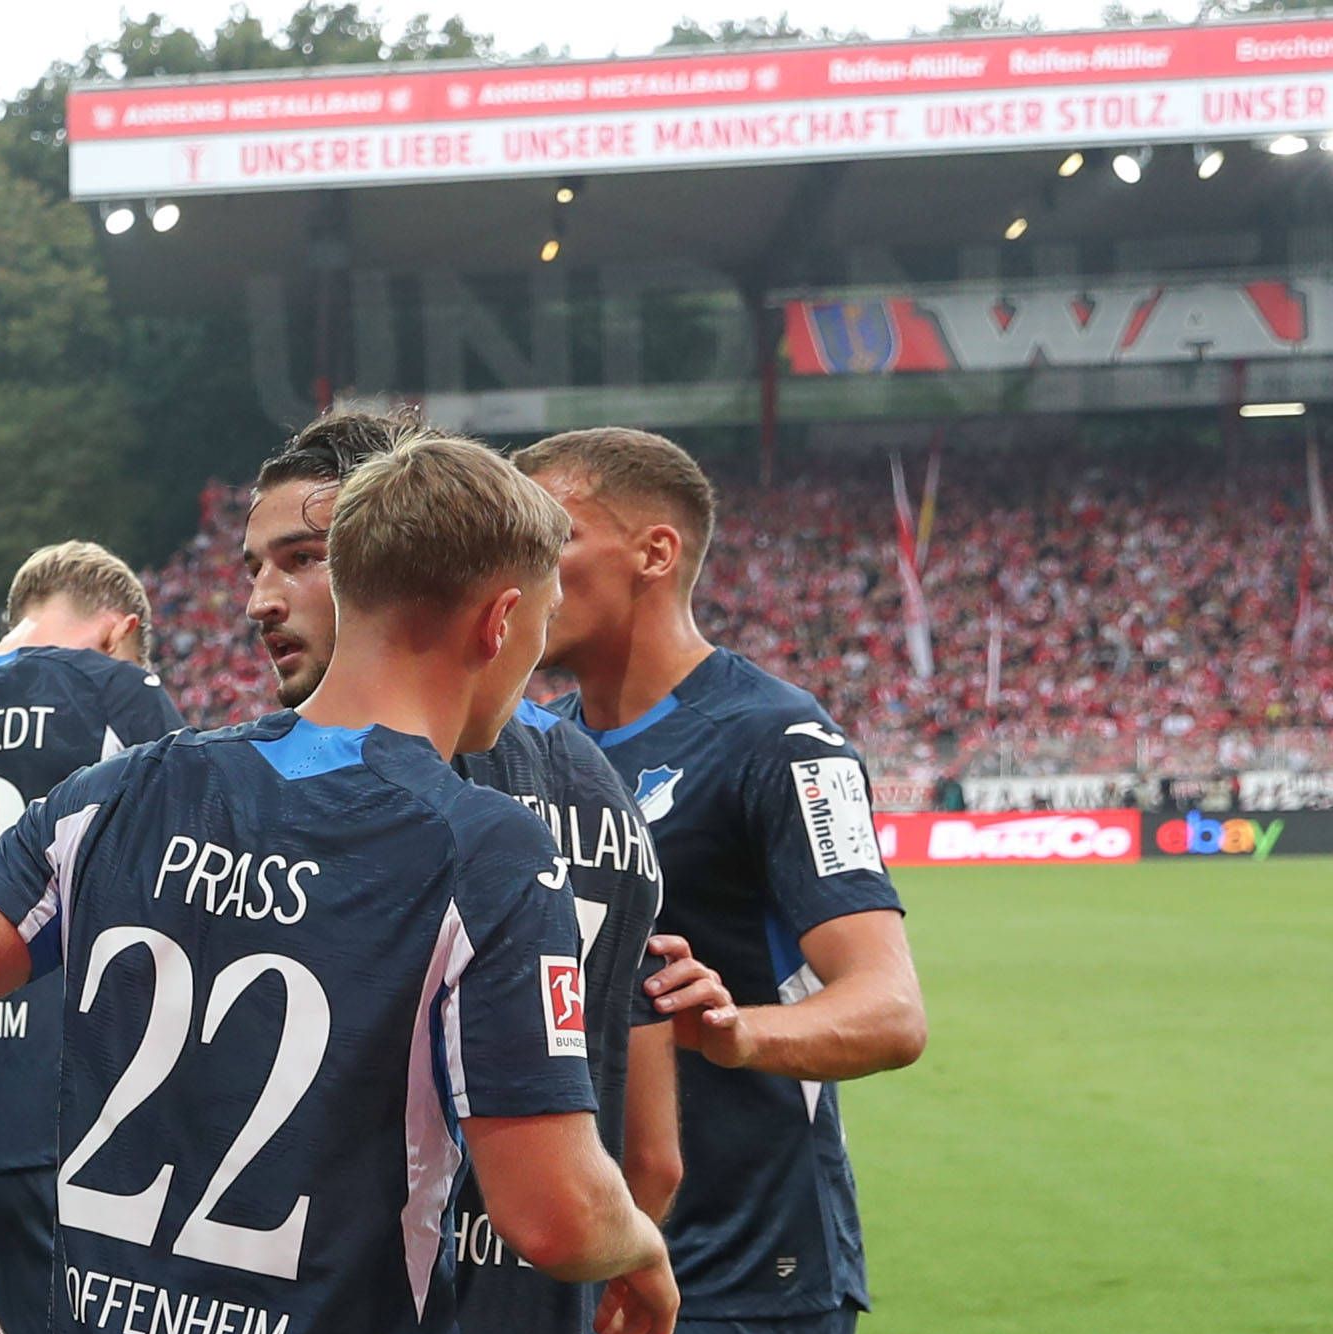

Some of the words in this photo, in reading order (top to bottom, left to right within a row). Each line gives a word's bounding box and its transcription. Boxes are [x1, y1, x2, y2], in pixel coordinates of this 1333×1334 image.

[240, 139, 369, 176] UNSERE
[503, 125, 642, 162] UNSERE
[925, 101, 1041, 138] UNSER
[1202, 85, 1326, 124] UNSER
[798, 761, 846, 873] ProMinent
[1156, 809, 1285, 861] ebay
[154, 834, 321, 925] PRASS
[555, 1036, 586, 1049] BUNDE
[58, 925, 331, 1280] 22
